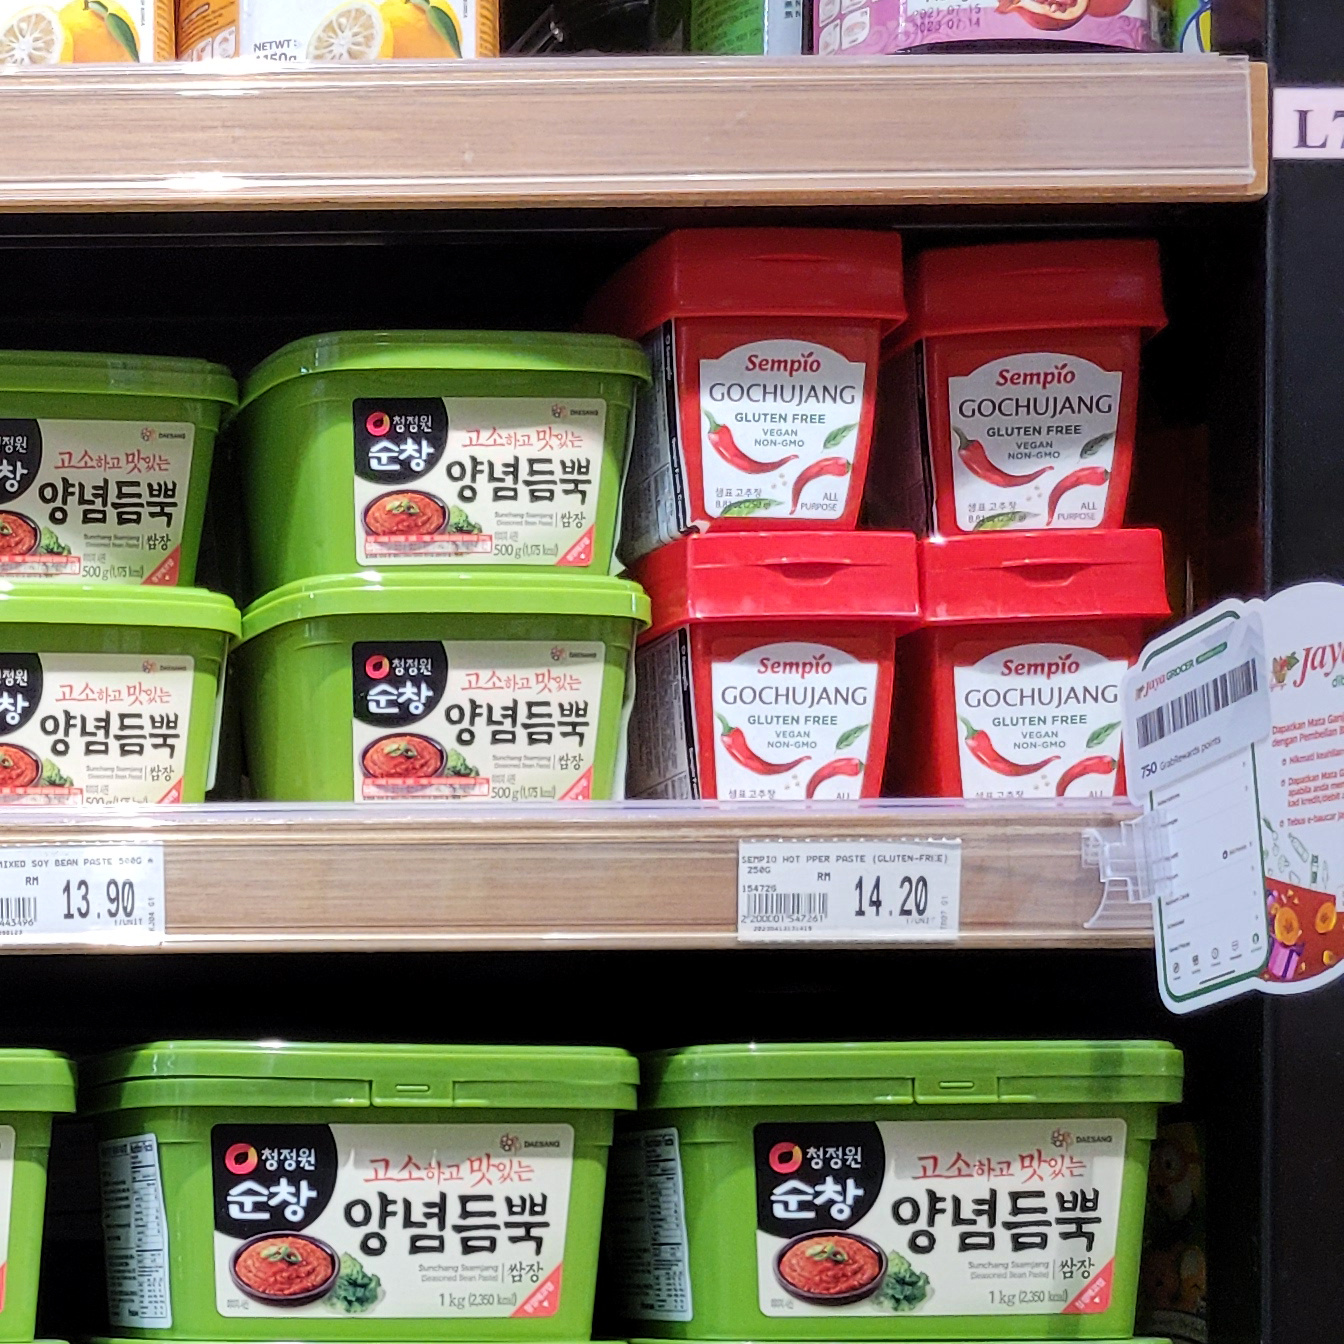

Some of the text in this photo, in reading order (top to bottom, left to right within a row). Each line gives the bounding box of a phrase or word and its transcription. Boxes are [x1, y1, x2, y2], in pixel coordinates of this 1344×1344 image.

[745, 349, 822, 378] Sempio
[995, 362, 1076, 389] Sempio
[708, 382, 857, 407] GOCHUJANG
[958, 394, 1113, 419] GOCHUJANG
[392, 413, 434, 433] 청정원
[734, 411, 826, 425] GLUTEN FREE
[461, 426, 585, 452] 고소하고 맛있는
[753, 438, 805, 448] NON-GMO
[761, 428, 799, 438] VEGAN
[367, 438, 436, 472] 순창
[445, 454, 593, 506] 양념듬뿍
[38, 476, 179, 529] 양념듬뿍
[822, 491, 839, 501] ALL
[757, 652, 833, 679] Sempio
[1001, 652, 1080, 679] Sempio
[721, 684, 868, 708] GOCHUJANG
[964, 683, 1120, 708] GOCHUJANG
[443, 697, 590, 748] 양념듬뿍
[747, 713, 839, 726] GLUTEN FREE
[39, 708, 181, 760] 양념듬뿍
[1140, 761, 1158, 780] 750
[741, 854, 779, 864] SEMPIO
[782, 854, 801, 864] HOT
[805, 854, 831, 864] PPER
[835, 854, 868, 864] PASTE
[62, 878, 136, 921] 13.90
[854, 875, 929, 918] 14.20
[343, 1189, 551, 1257] 양념듬뿍
[891, 1187, 1103, 1255] 양념듬뿍
